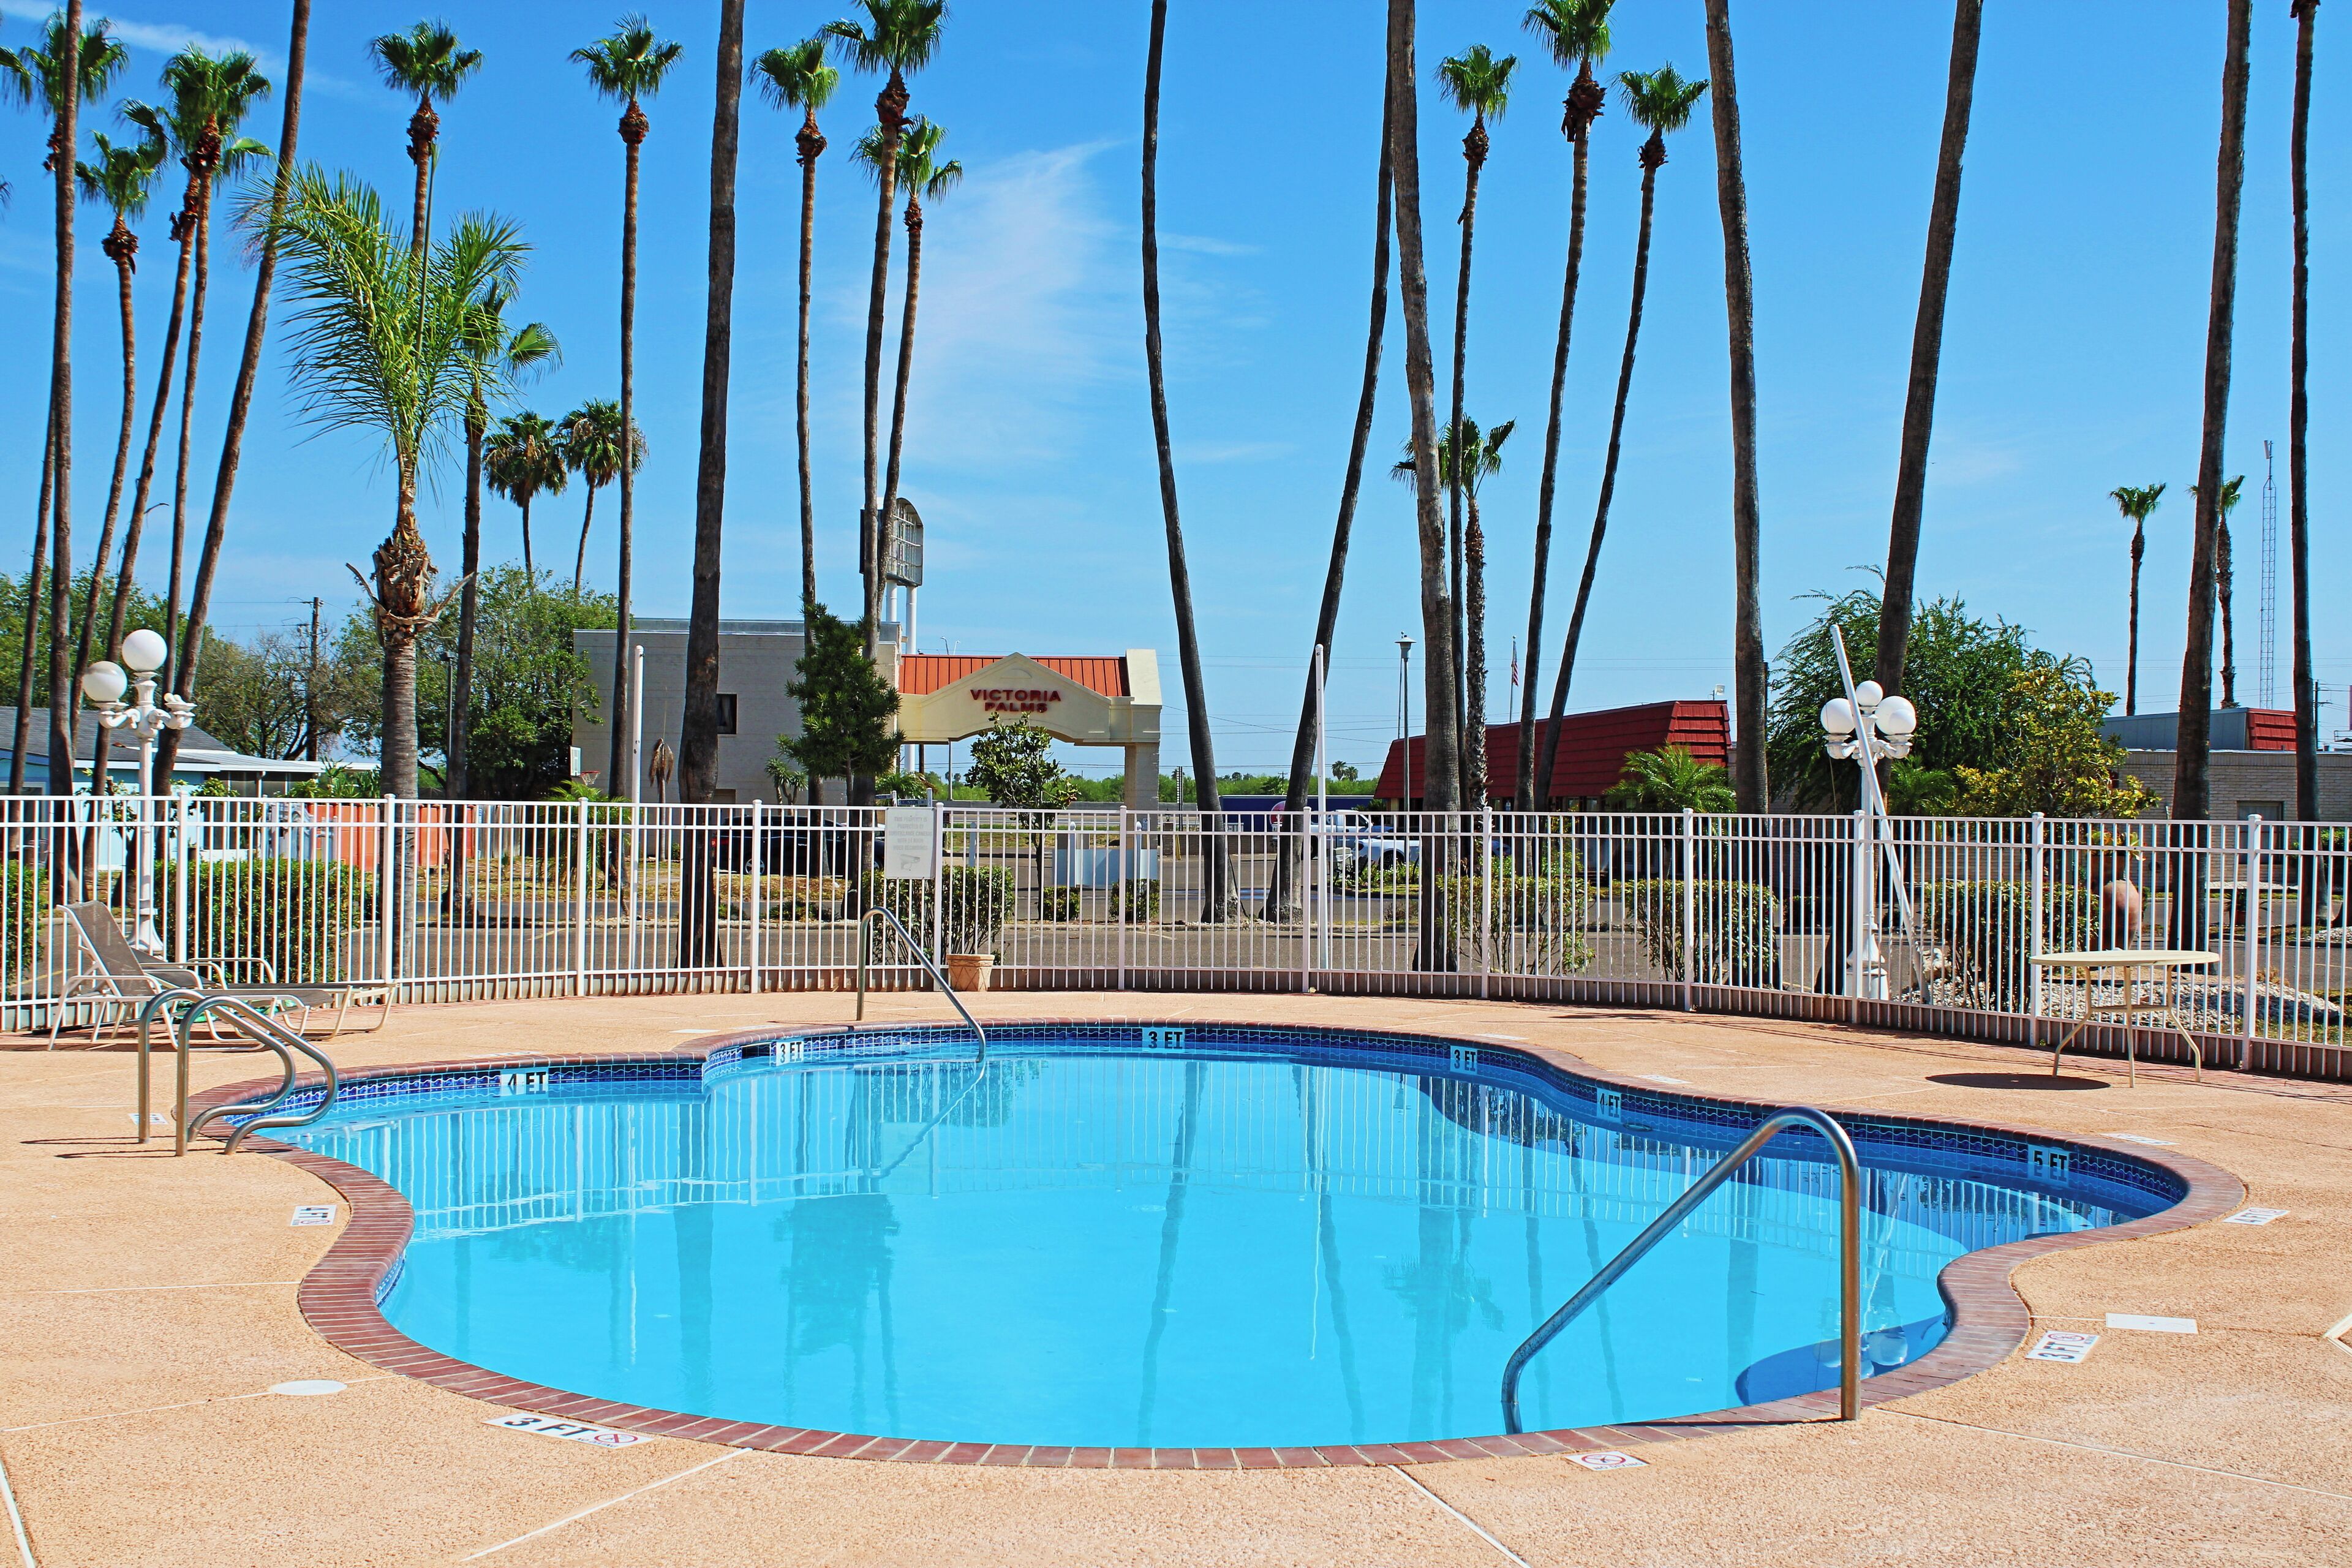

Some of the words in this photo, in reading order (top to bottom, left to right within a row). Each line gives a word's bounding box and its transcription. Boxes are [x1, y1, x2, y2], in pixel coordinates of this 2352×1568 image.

[970, 689, 1061, 701] VICTORIA
[984, 702, 1048, 713] PALMS
[2049, 1153, 2067, 1170] FT
[2043, 1341, 2084, 1352] FT
[504, 1417, 542, 1426] 3
[535, 1423, 598, 1436] FT
